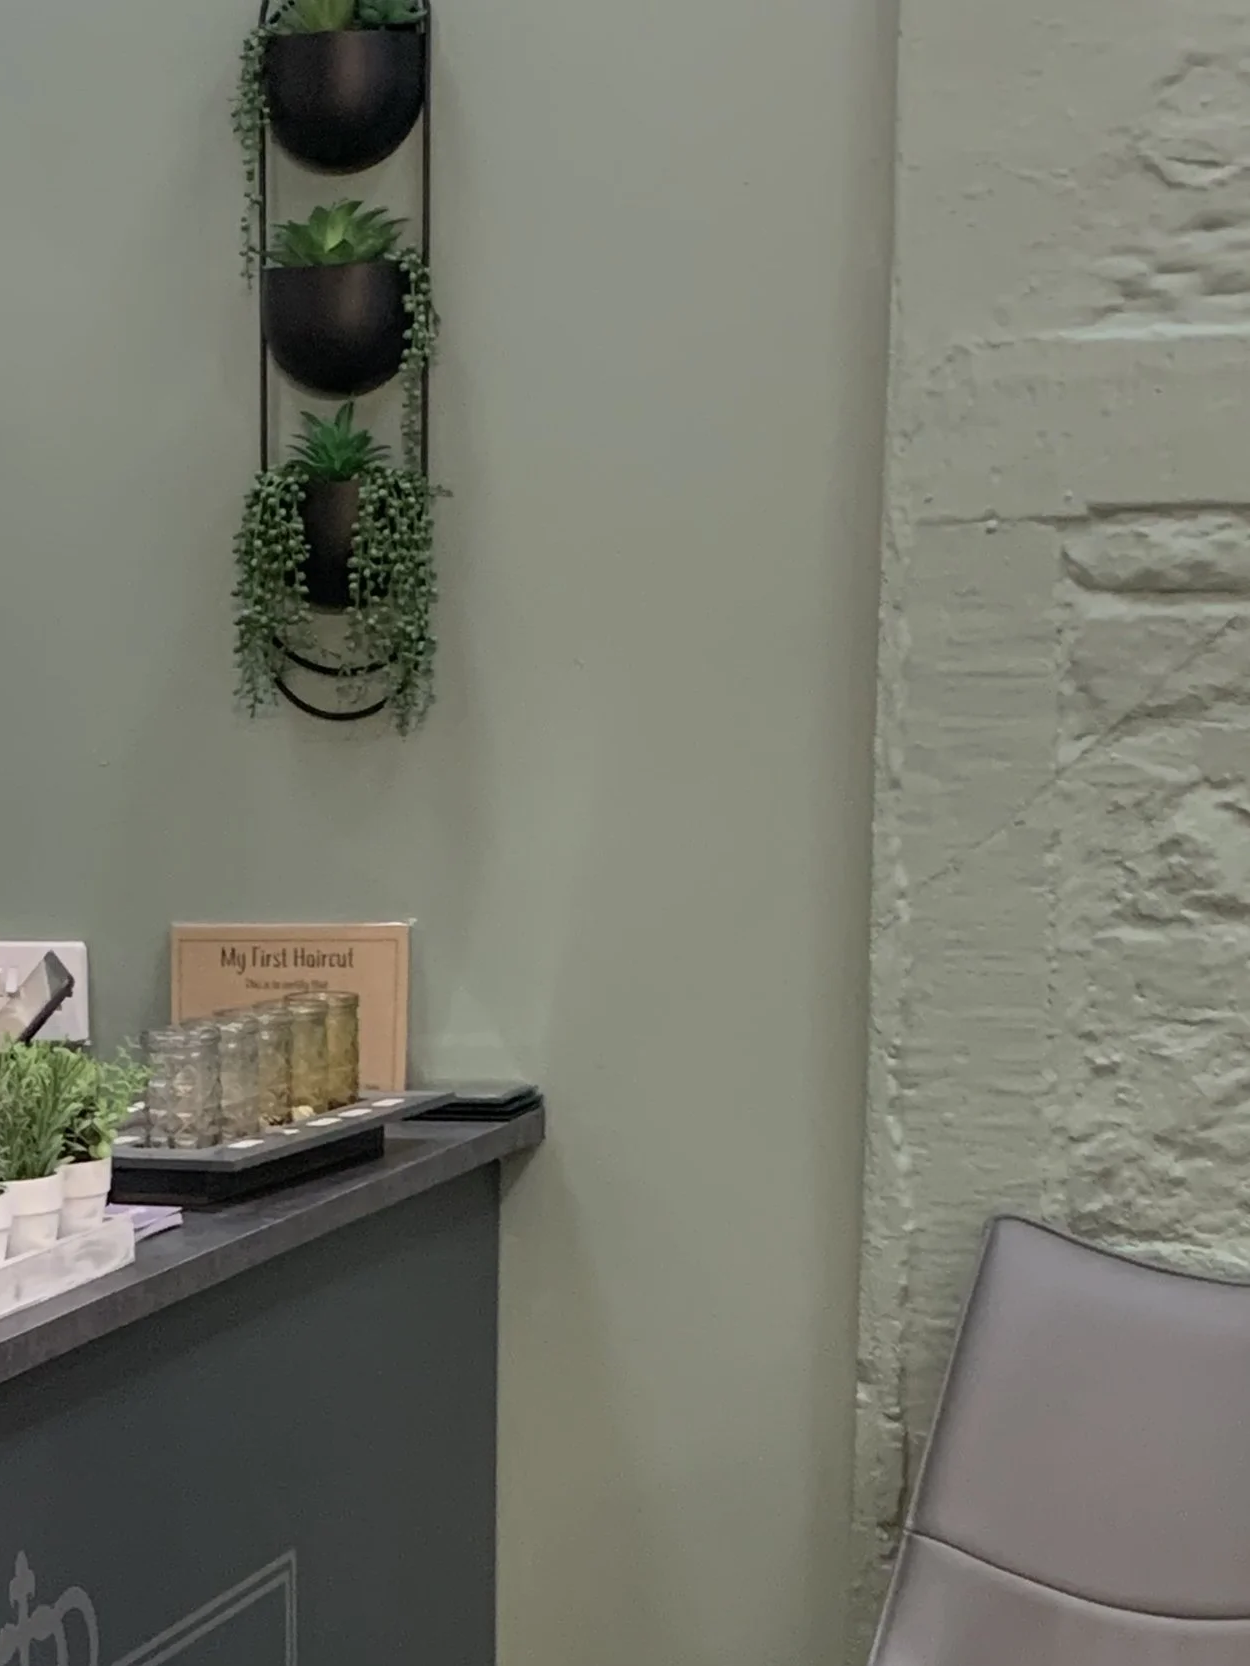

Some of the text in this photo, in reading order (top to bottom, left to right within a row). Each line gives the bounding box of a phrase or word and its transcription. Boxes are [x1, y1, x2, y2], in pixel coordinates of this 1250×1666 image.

[220, 946, 355, 975] My First Haircut
